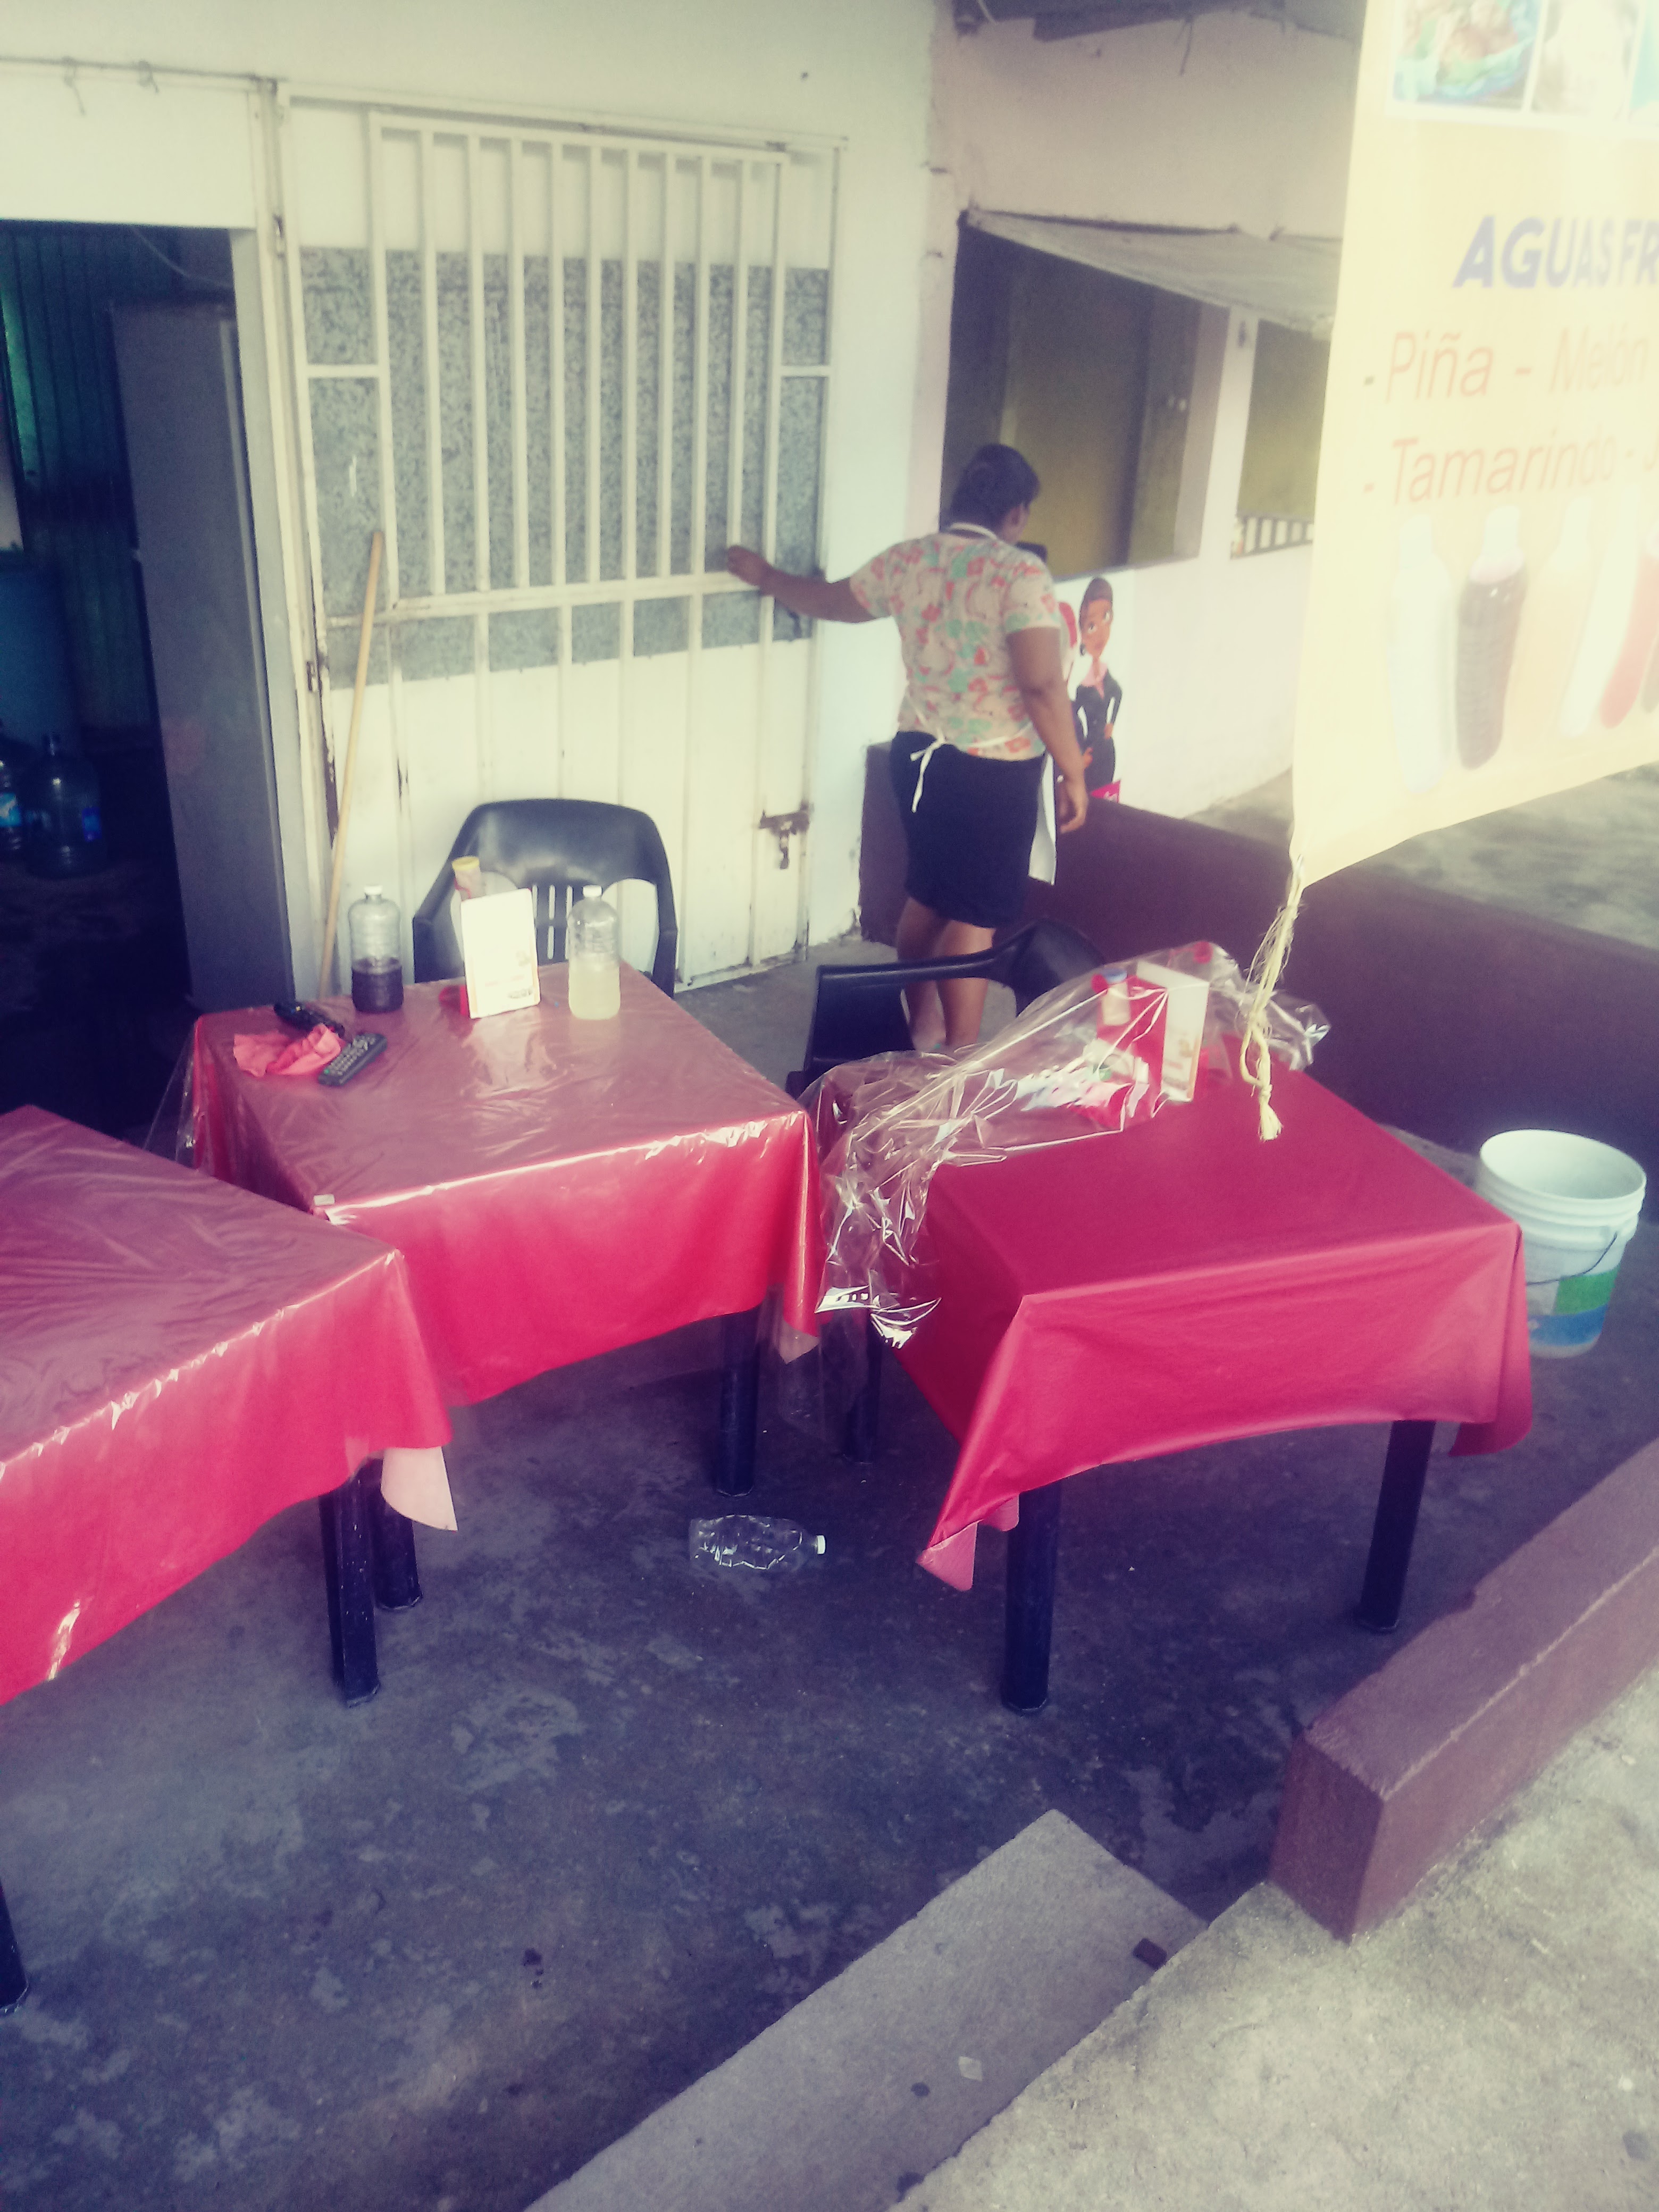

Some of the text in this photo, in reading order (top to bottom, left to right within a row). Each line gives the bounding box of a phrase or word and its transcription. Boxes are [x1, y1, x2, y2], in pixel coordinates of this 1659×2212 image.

[1452, 215, 1615, 289] AGUAS
[1549, 323, 1649, 394] Melón
[1392, 424, 1616, 507] Tamarindo
